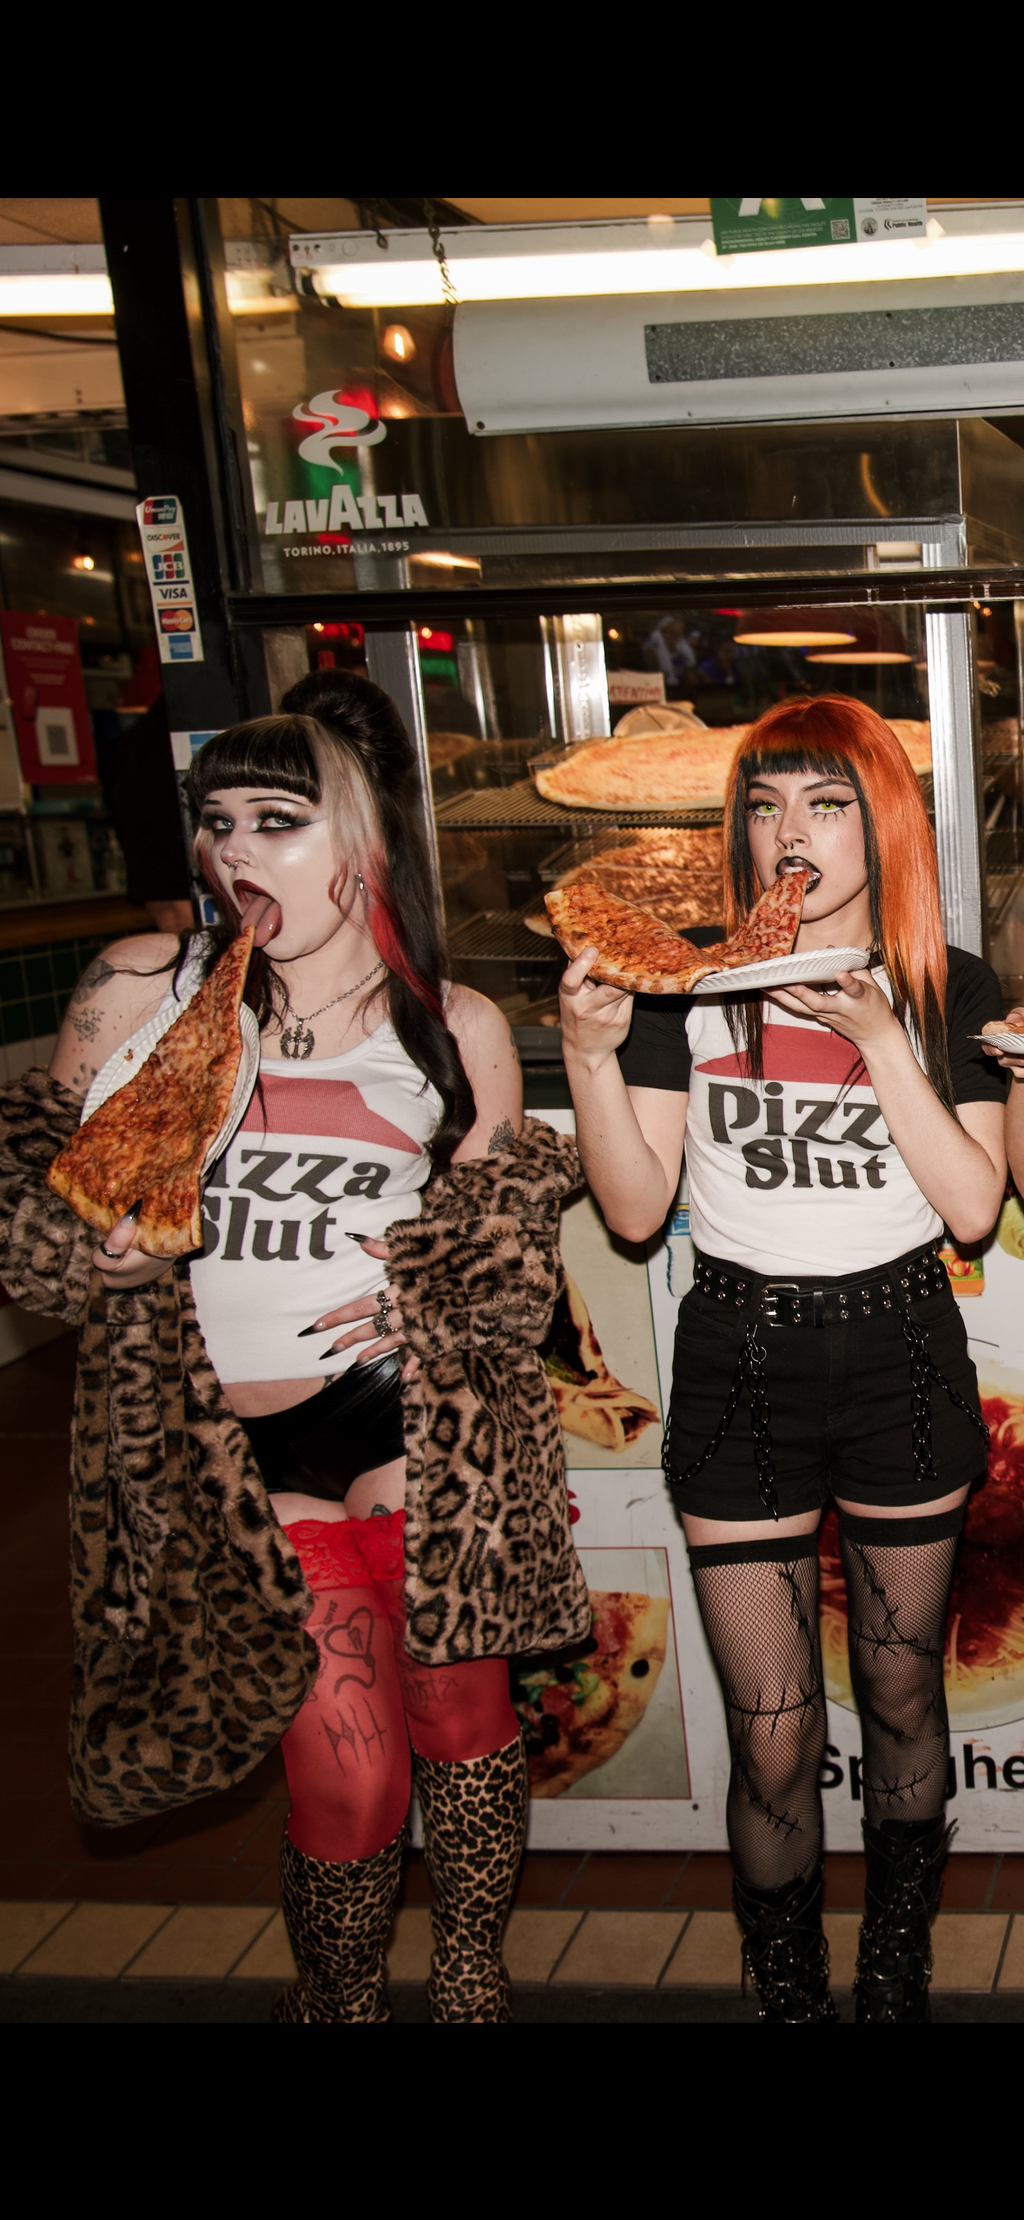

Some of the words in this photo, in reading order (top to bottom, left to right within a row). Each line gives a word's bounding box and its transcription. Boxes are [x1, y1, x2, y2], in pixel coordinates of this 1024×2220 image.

[265, 484, 429, 535] LAVAZZA
[154, 561, 184, 572] JCB
[158, 587, 188, 599] VISA
[708, 1081, 896, 1151] Pizz
[742, 1138, 887, 1190] Slut
